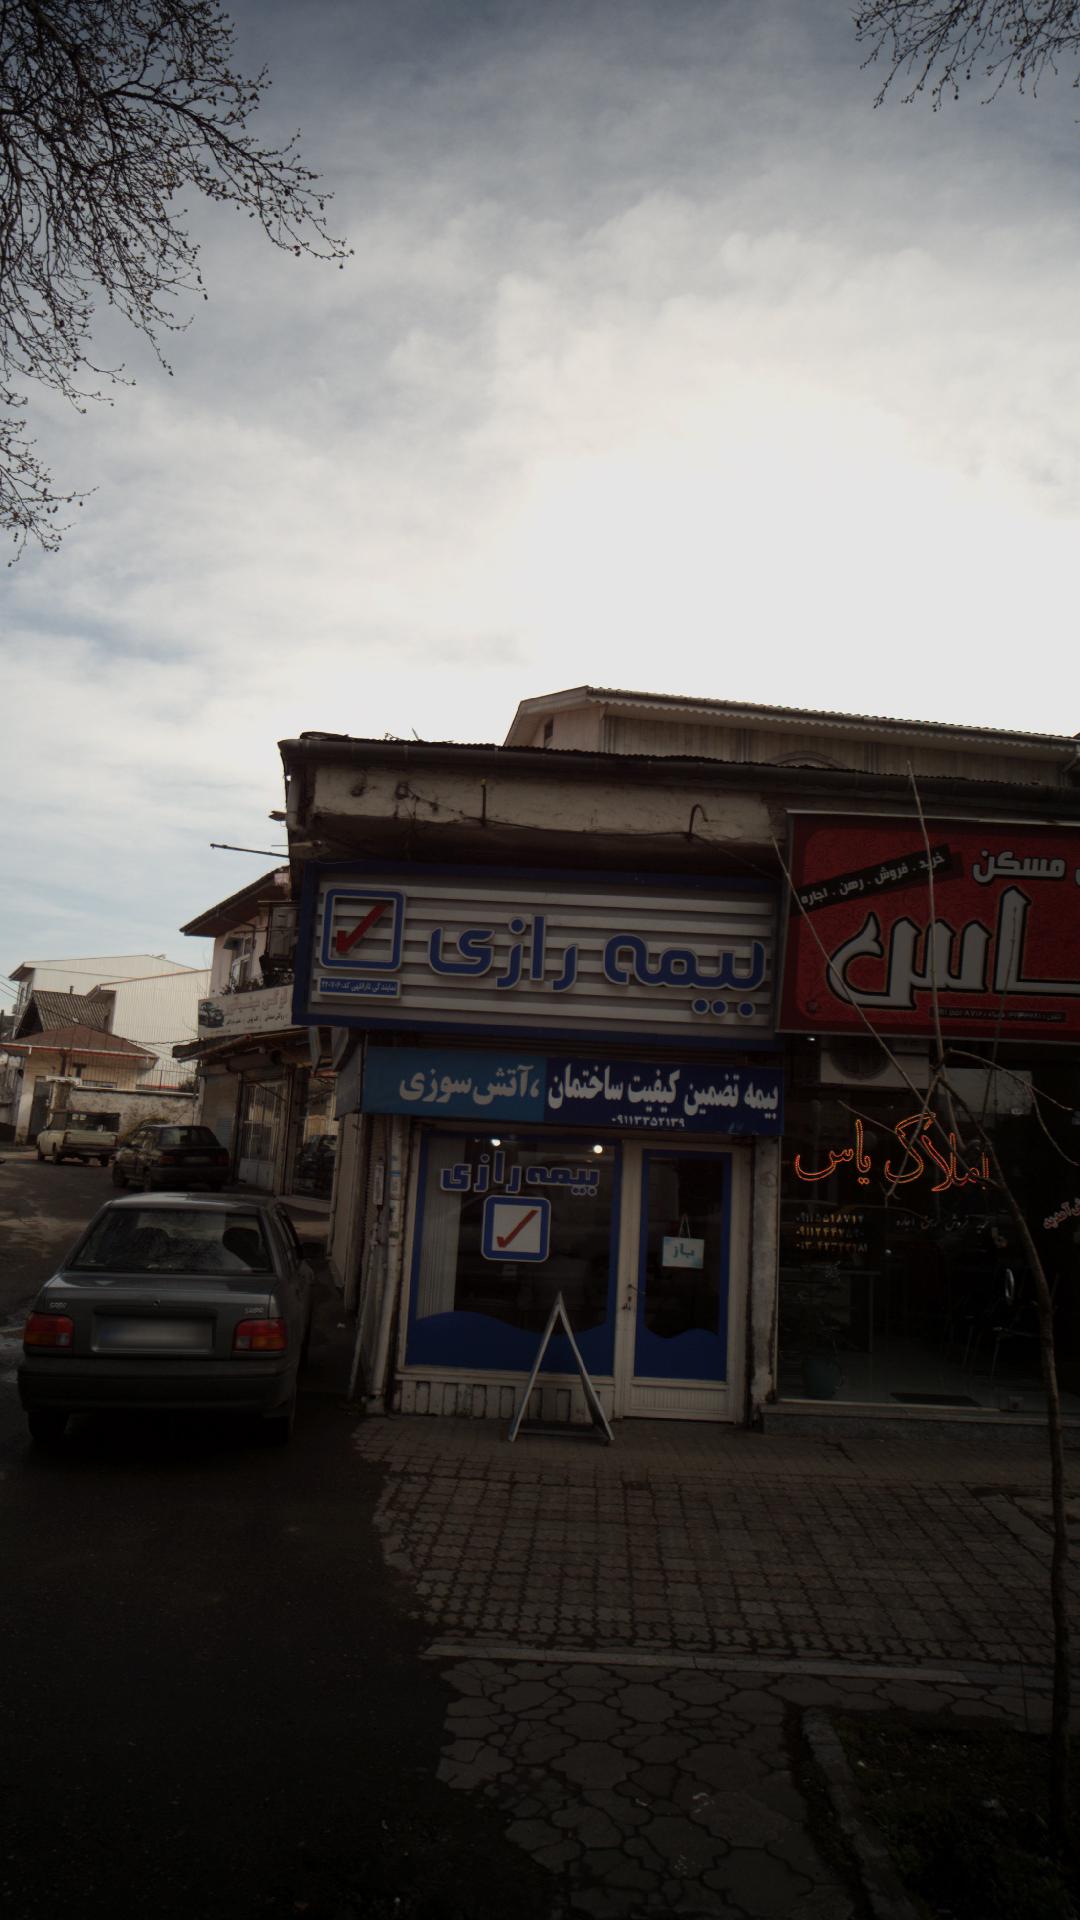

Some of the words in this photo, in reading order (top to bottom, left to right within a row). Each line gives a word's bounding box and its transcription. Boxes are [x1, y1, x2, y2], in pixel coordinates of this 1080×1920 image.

[838, 878, 865, 896] رهن
[873, 862, 909, 885] فروش
[973, 850, 1066, 884] مسکن
[800, 888, 829, 906] اجاره
[427, 915, 580, 991] رازی
[603, 934, 768, 1018] بیمه
[547, 1063, 624, 1111] ساختمان
[626, 1069, 682, 1113] کیفیت
[683, 1072, 740, 1116] تضمین
[743, 1081, 780, 1121] بیمه
[440, 1150, 522, 1194] رازی
[794, 1119, 872, 1185] یاس
[526, 1165, 601, 1197] بیمه
[672, 1243, 695, 1259] باز
